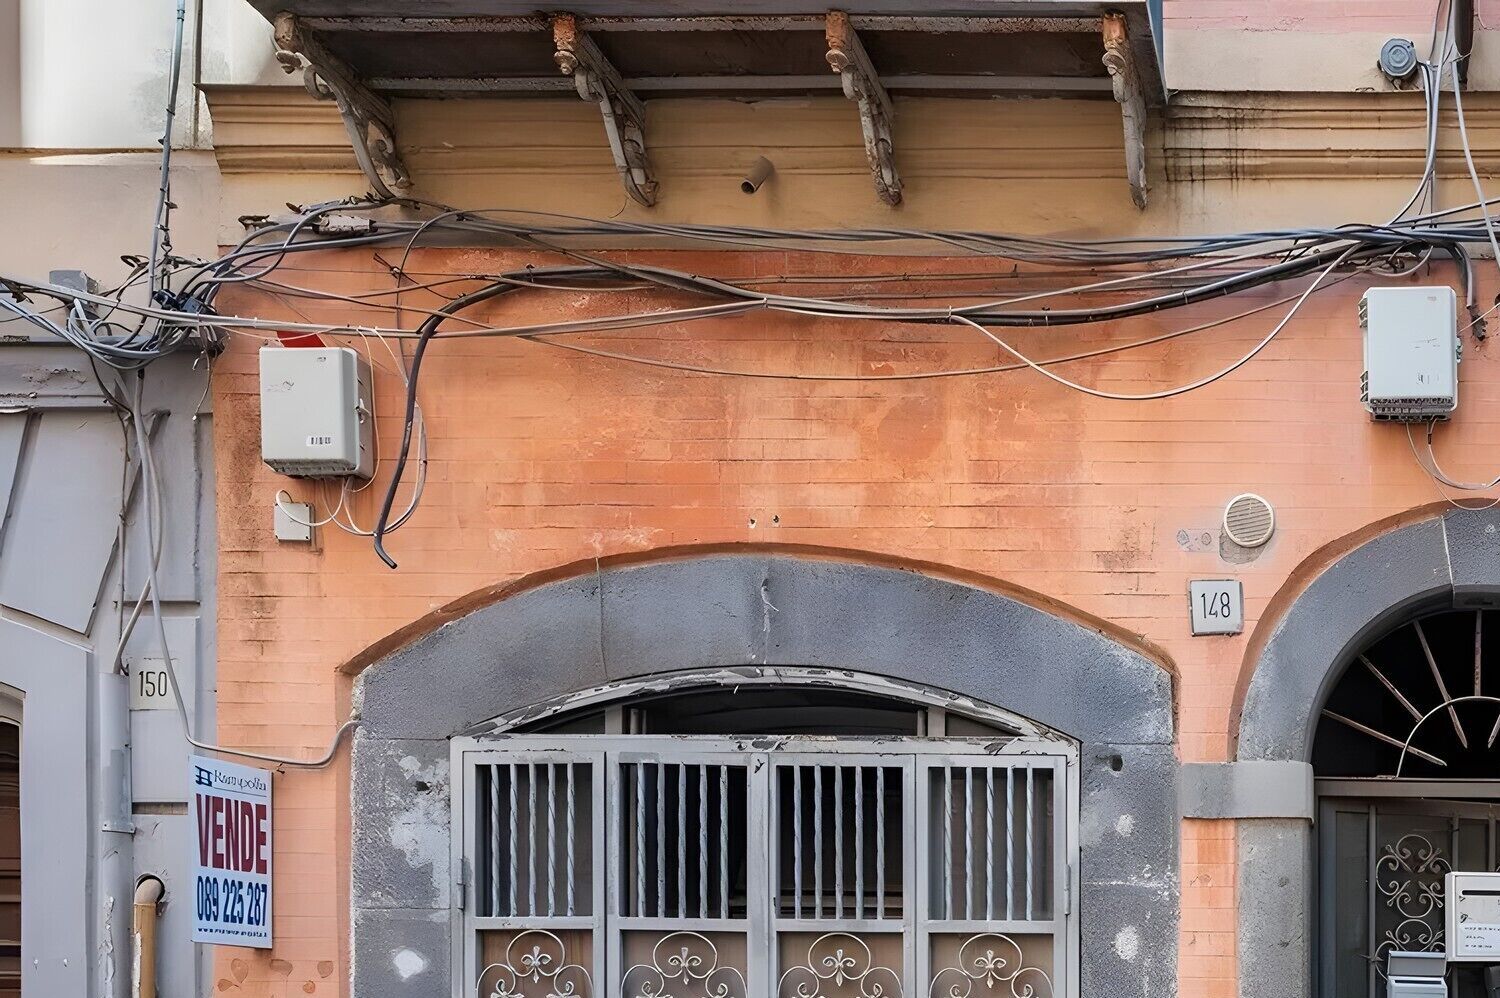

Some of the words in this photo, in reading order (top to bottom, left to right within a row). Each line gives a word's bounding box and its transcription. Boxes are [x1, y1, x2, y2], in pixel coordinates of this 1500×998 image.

[1201, 591, 1231, 619] 148
[138, 670, 168, 697] 150
[196, 793, 268, 875] VENDE
[197, 875, 219, 922] 089
[222, 878, 245, 925] 225
[246, 881, 268, 927] 287
